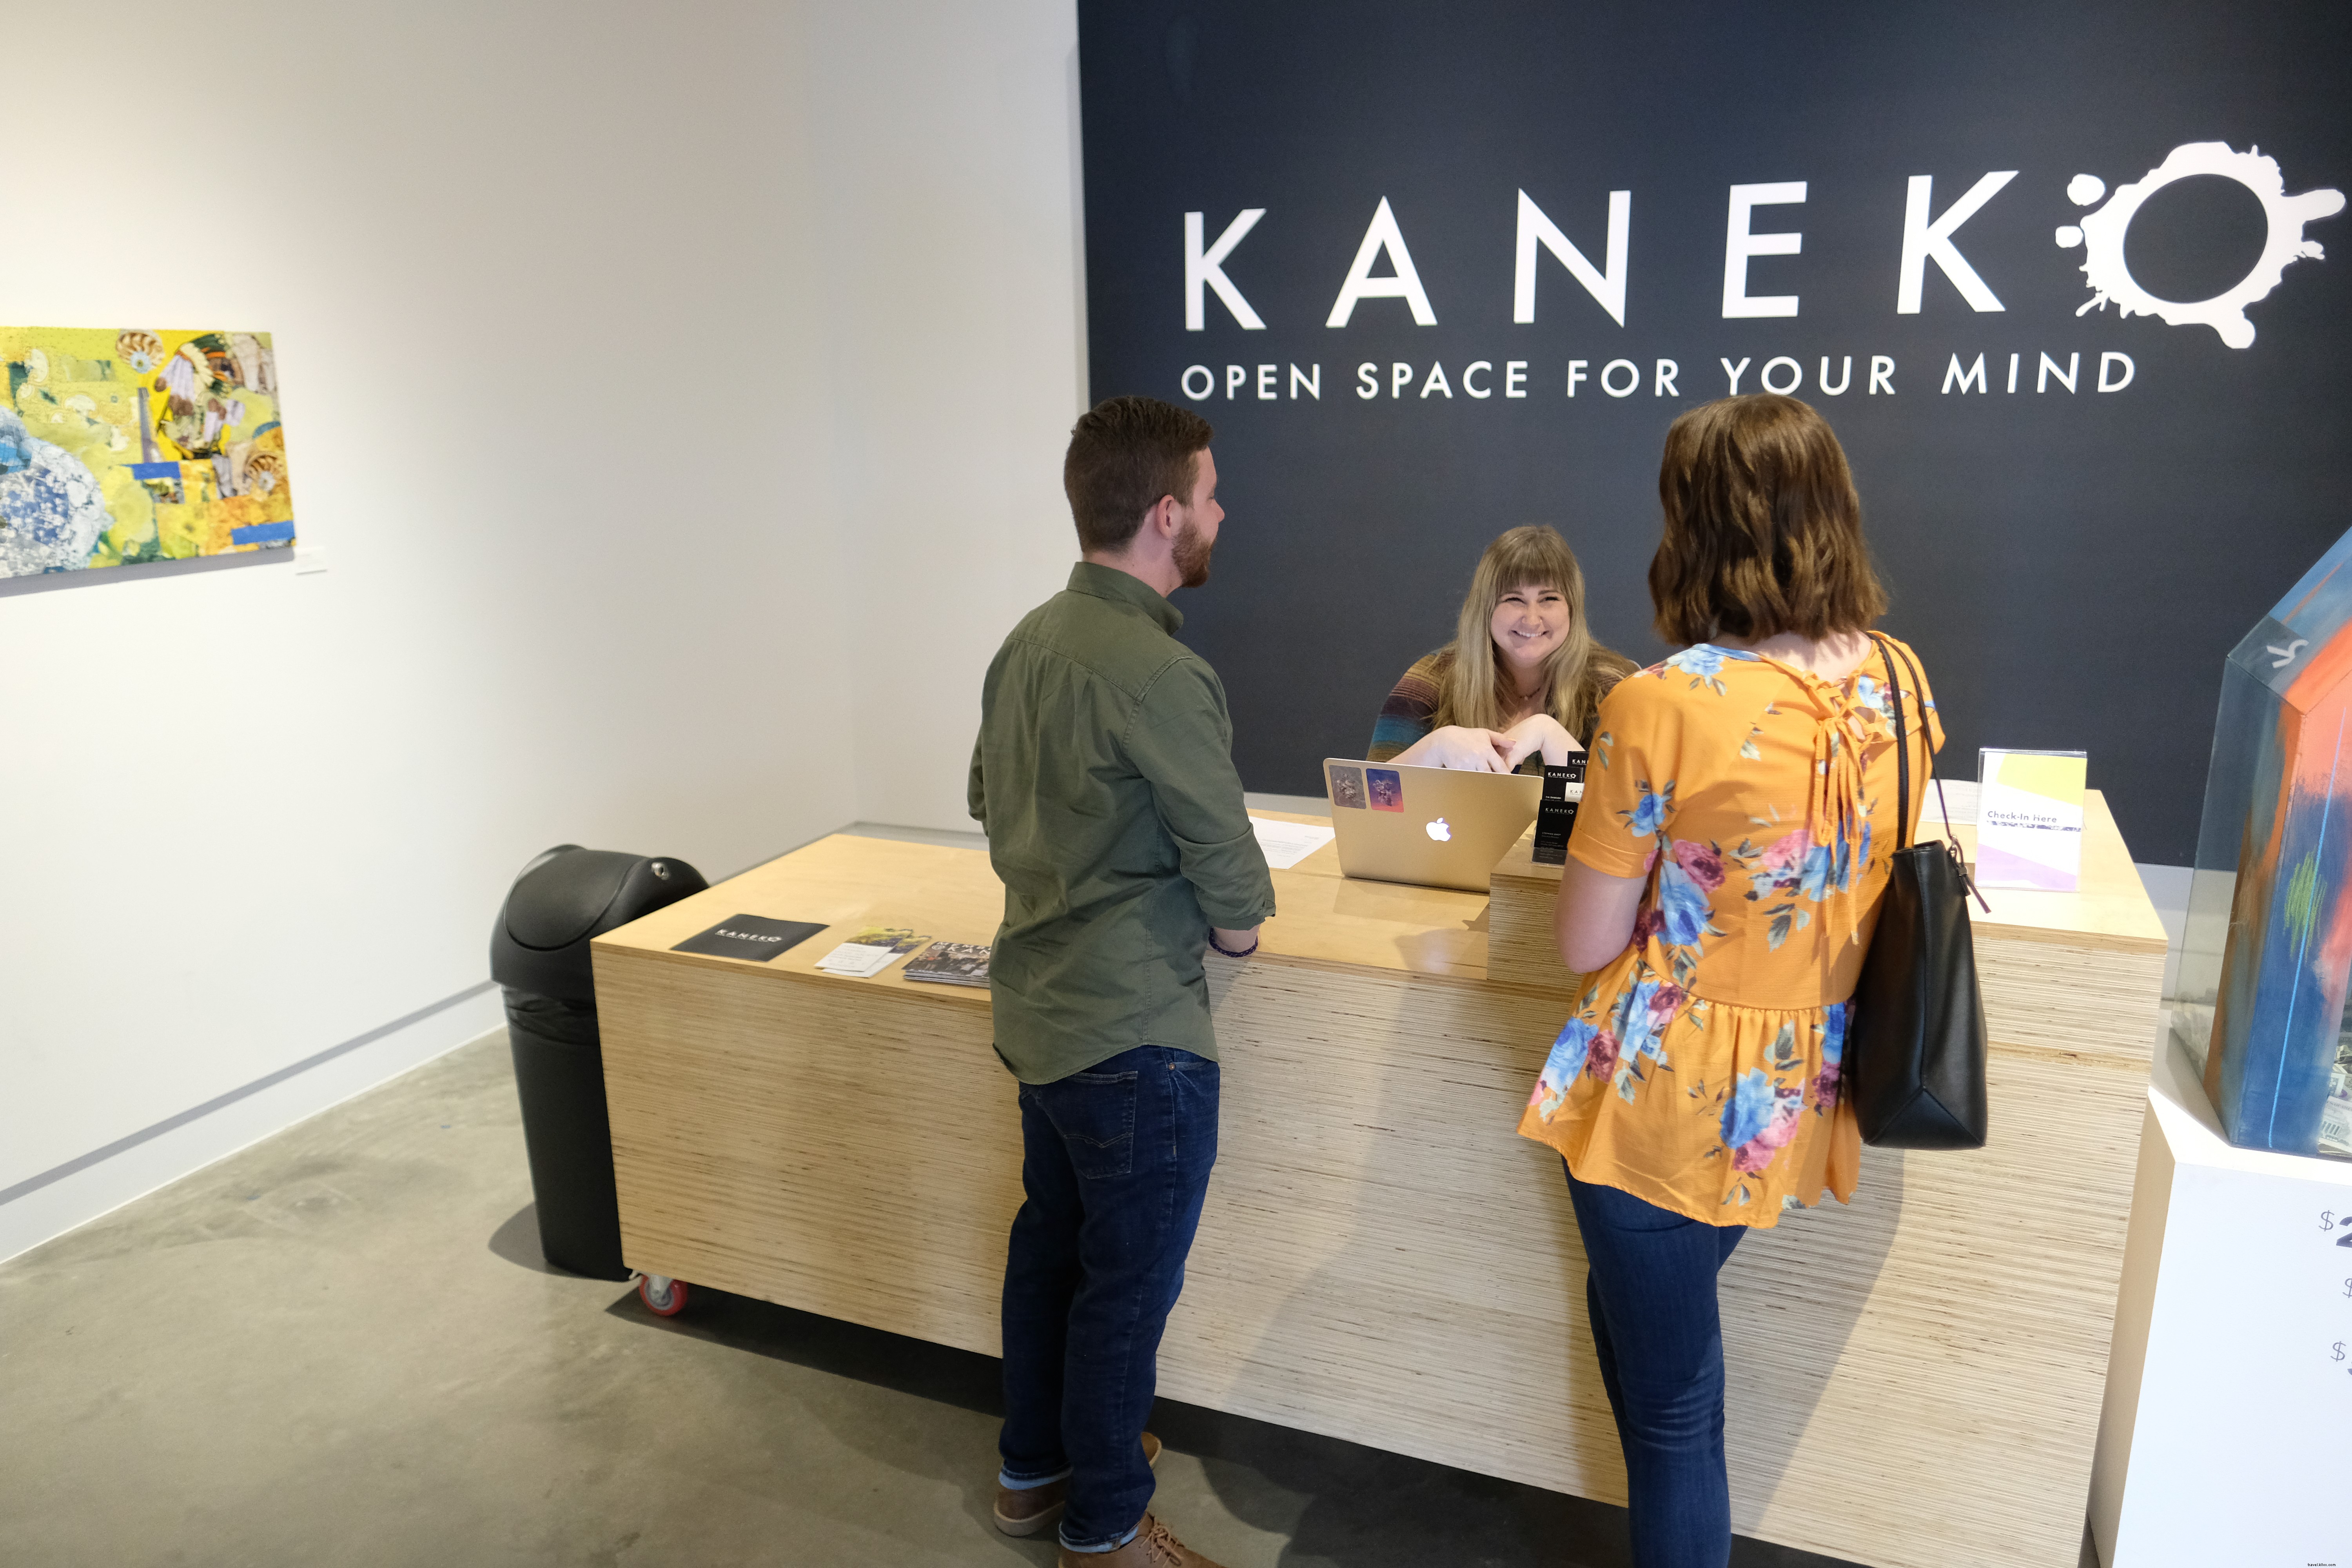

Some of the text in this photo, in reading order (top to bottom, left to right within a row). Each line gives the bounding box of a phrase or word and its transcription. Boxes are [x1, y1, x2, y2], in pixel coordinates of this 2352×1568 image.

[1184, 141, 2346, 349] KANEKO
[1181, 351, 2135, 400] OPEN SPACE FOR YOUR MIND
[1987, 811, 2057, 823] Check-In Here
[715, 929, 782, 942] KANEKO
